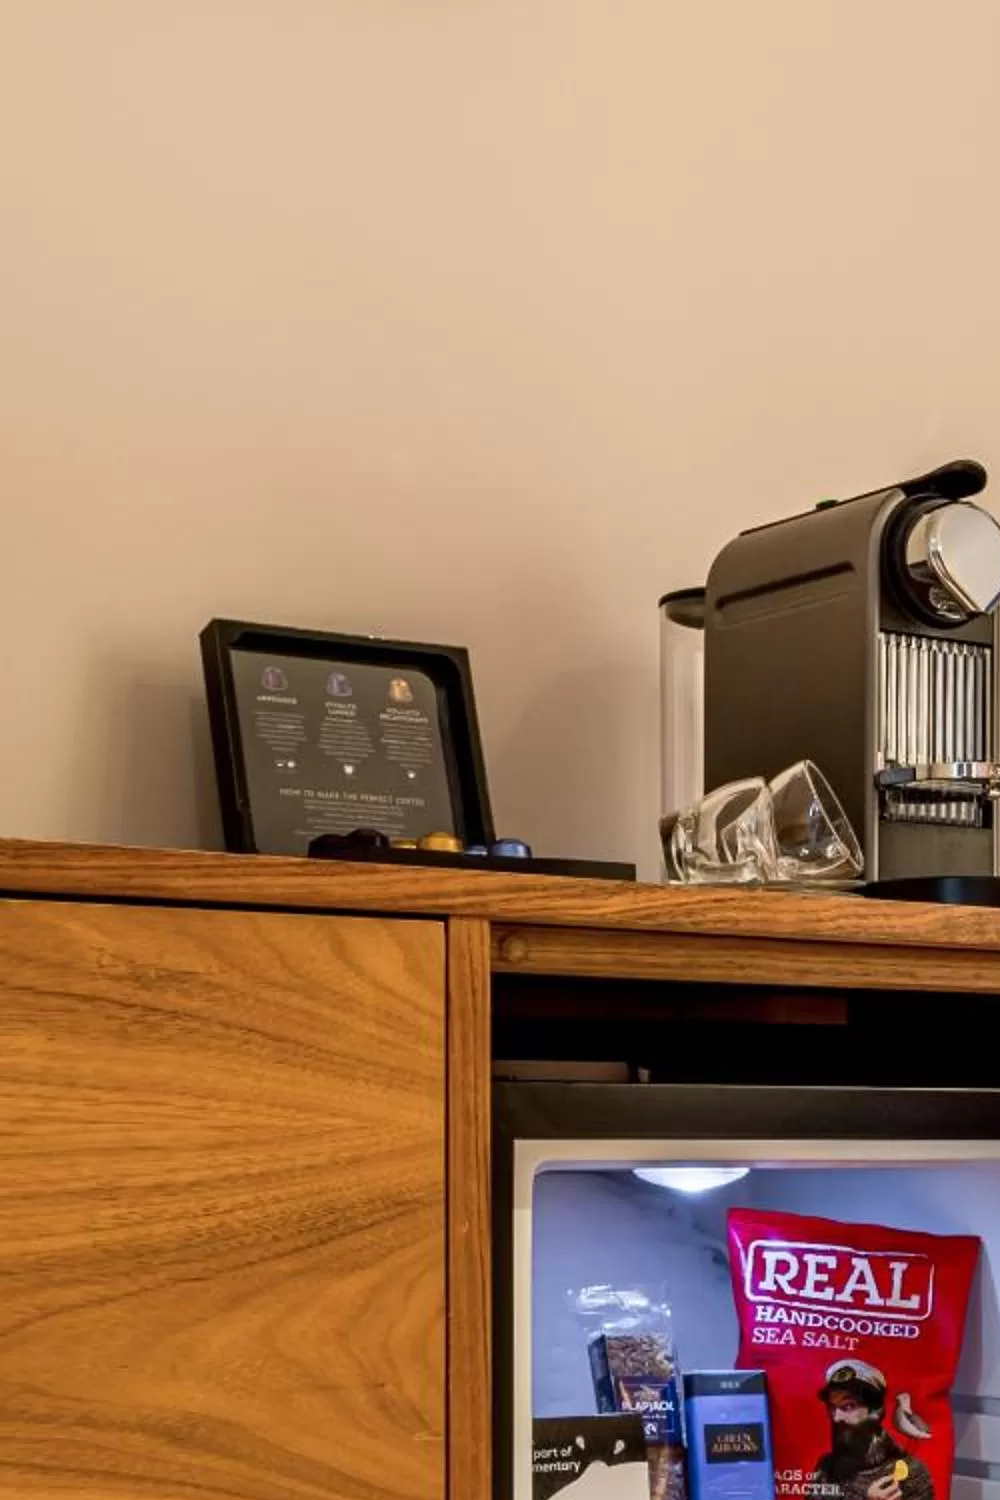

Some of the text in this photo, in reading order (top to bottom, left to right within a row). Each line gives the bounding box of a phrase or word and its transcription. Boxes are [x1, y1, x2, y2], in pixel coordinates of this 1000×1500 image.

[759, 1251, 921, 1309] REAL
[752, 1327, 860, 1351] SEA SALT
[755, 1305, 921, 1339] HANDCOOKED
